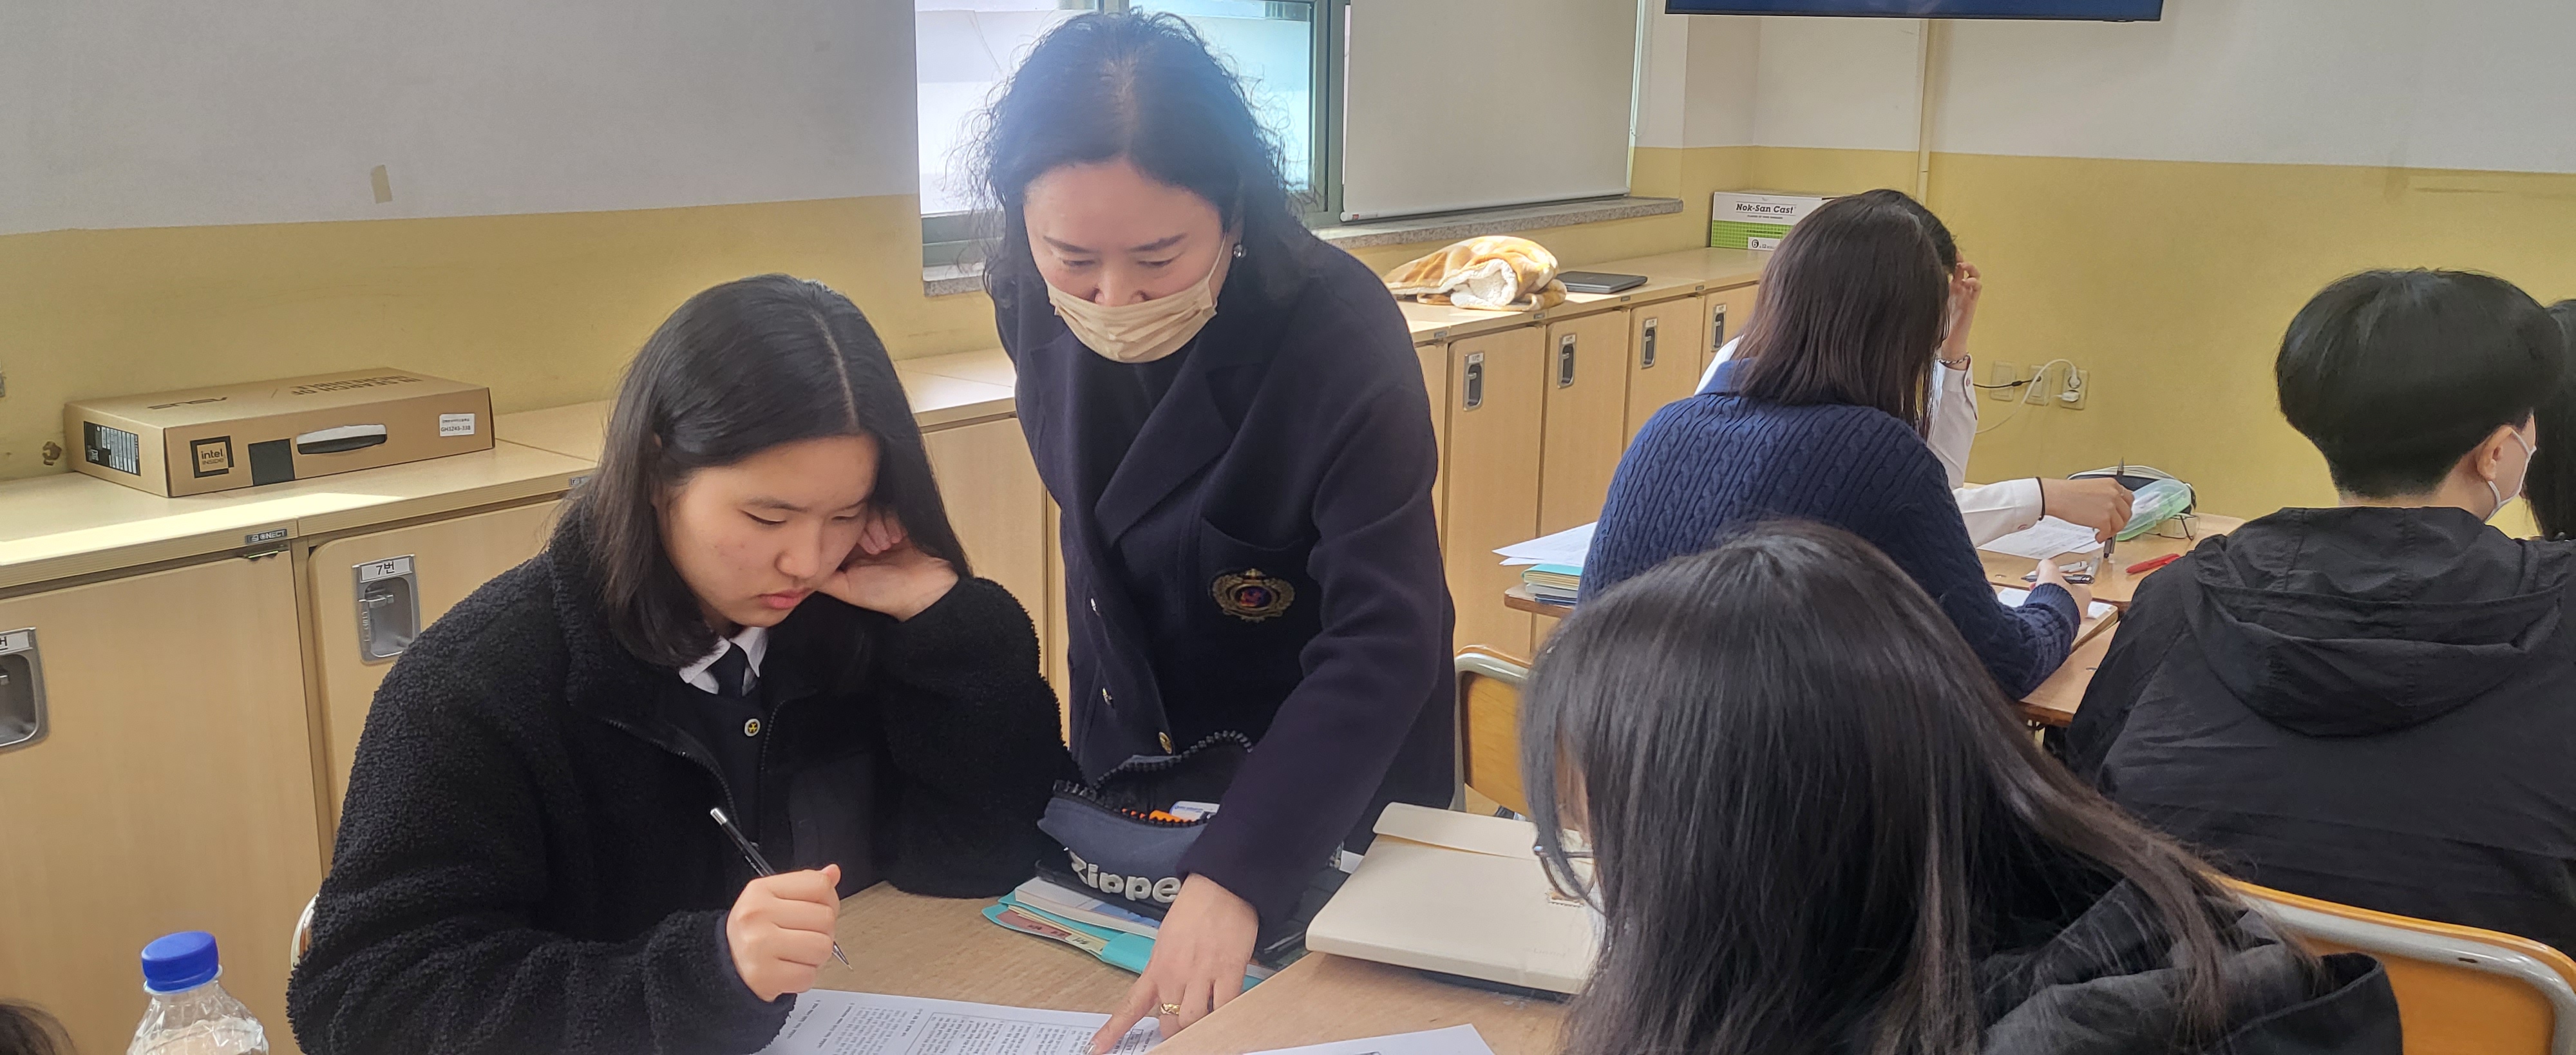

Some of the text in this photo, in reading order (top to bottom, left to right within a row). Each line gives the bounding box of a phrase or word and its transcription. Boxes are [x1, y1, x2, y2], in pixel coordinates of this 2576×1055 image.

[1736, 203, 1794, 214] Nok-San Cast
[147, 397, 228, 410] ASUS
[200, 448, 223, 459] intel
[375, 560, 395, 575] 7번
